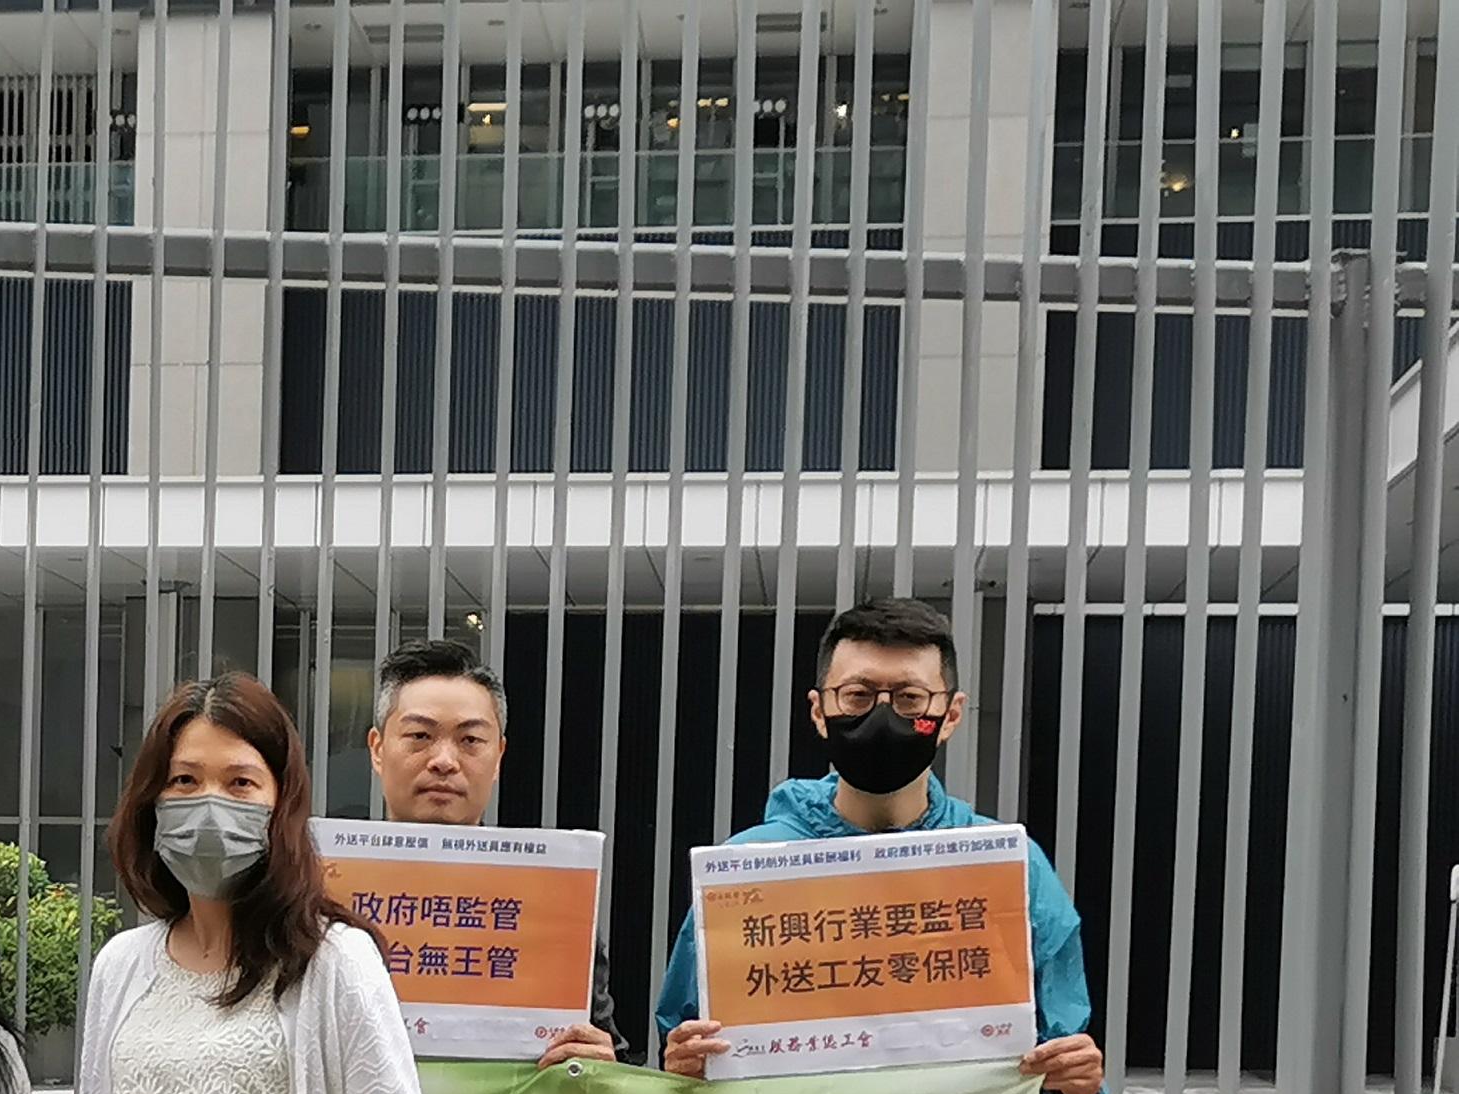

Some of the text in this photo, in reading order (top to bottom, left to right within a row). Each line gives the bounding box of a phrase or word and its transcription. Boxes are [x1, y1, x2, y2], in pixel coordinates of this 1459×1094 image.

[351, 892, 523, 931] 政府唔監管
[742, 896, 989, 948] 新興行業要監管
[746, 945, 992, 997] 外送工友零保障
